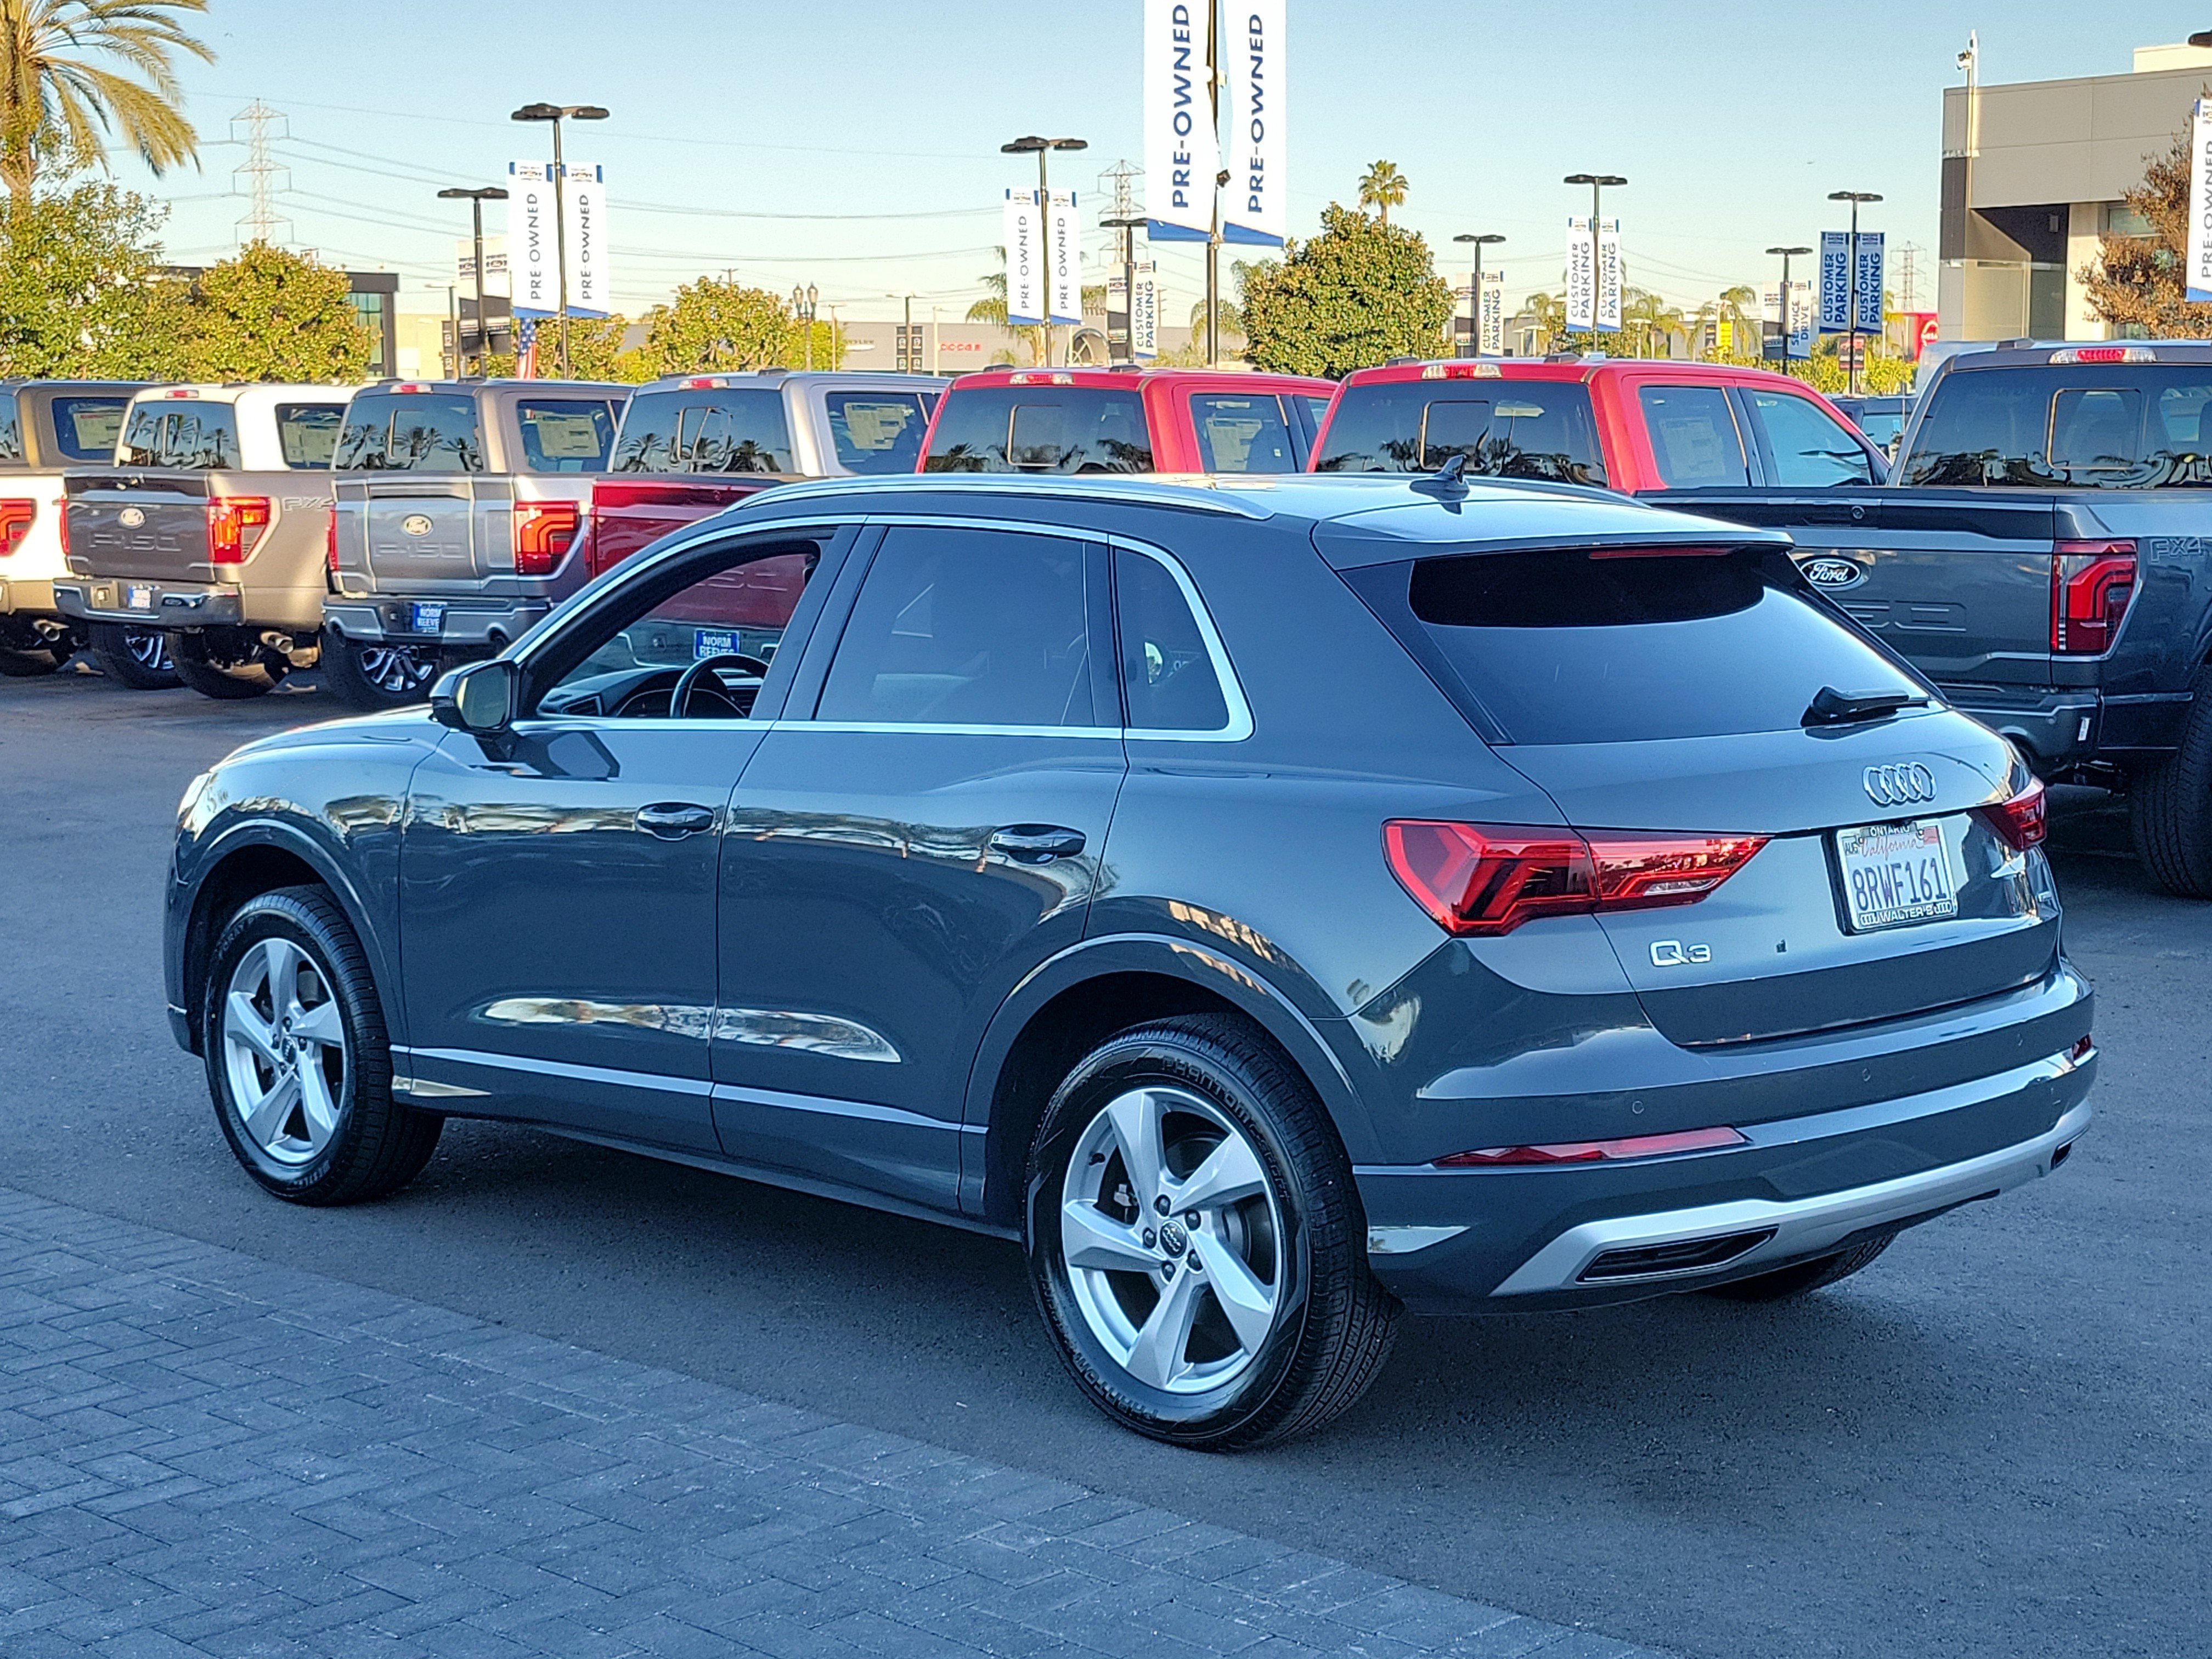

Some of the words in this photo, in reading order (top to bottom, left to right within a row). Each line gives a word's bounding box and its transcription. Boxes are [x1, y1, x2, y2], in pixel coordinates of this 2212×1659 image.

[1172, 4, 1192, 208] PRE-OWNED
[1248, 14, 1264, 213] PRE-OWNED
[527, 193, 541, 300] PRE-OWNED
[579, 194, 592, 300] PRE-OWNED
[1018, 216, 1030, 309] PRE-OWNED
[1057, 218, 1068, 309] PRE-OWNED
[1571, 243, 1579, 317] CUSTOMER
[1581, 242, 1590, 318] PARKING
[1608, 242, 1617, 318] PARKING
[1135, 282, 1144, 347] CUSTOMER
[1145, 280, 1154, 348] PARKING
[1482, 291, 1491, 348] CUSTOMER
[1492, 289, 1500, 349] PARKING
[1823, 253, 1834, 322] CUSTOMER
[1835, 252, 1847, 323] PARKING
[1859, 253, 1869, 322] CUSTOMER
[1869, 252, 1881, 323] PARKING
[1791, 300, 1800, 346] SERVICE
[1801, 306, 1809, 340] DRIVE
[1809, 562, 1848, 582] Ford
[2150, 538, 2204, 565] FX4
[703, 636, 731, 647] NORM
[1861, 835, 1925, 861] California
[1852, 857, 1947, 911] 8RWF161
[1880, 905, 1934, 923] WALTER'S
[1650, 940, 1711, 966] Q3
[1162, 1056, 1252, 1124] PHANTOM
